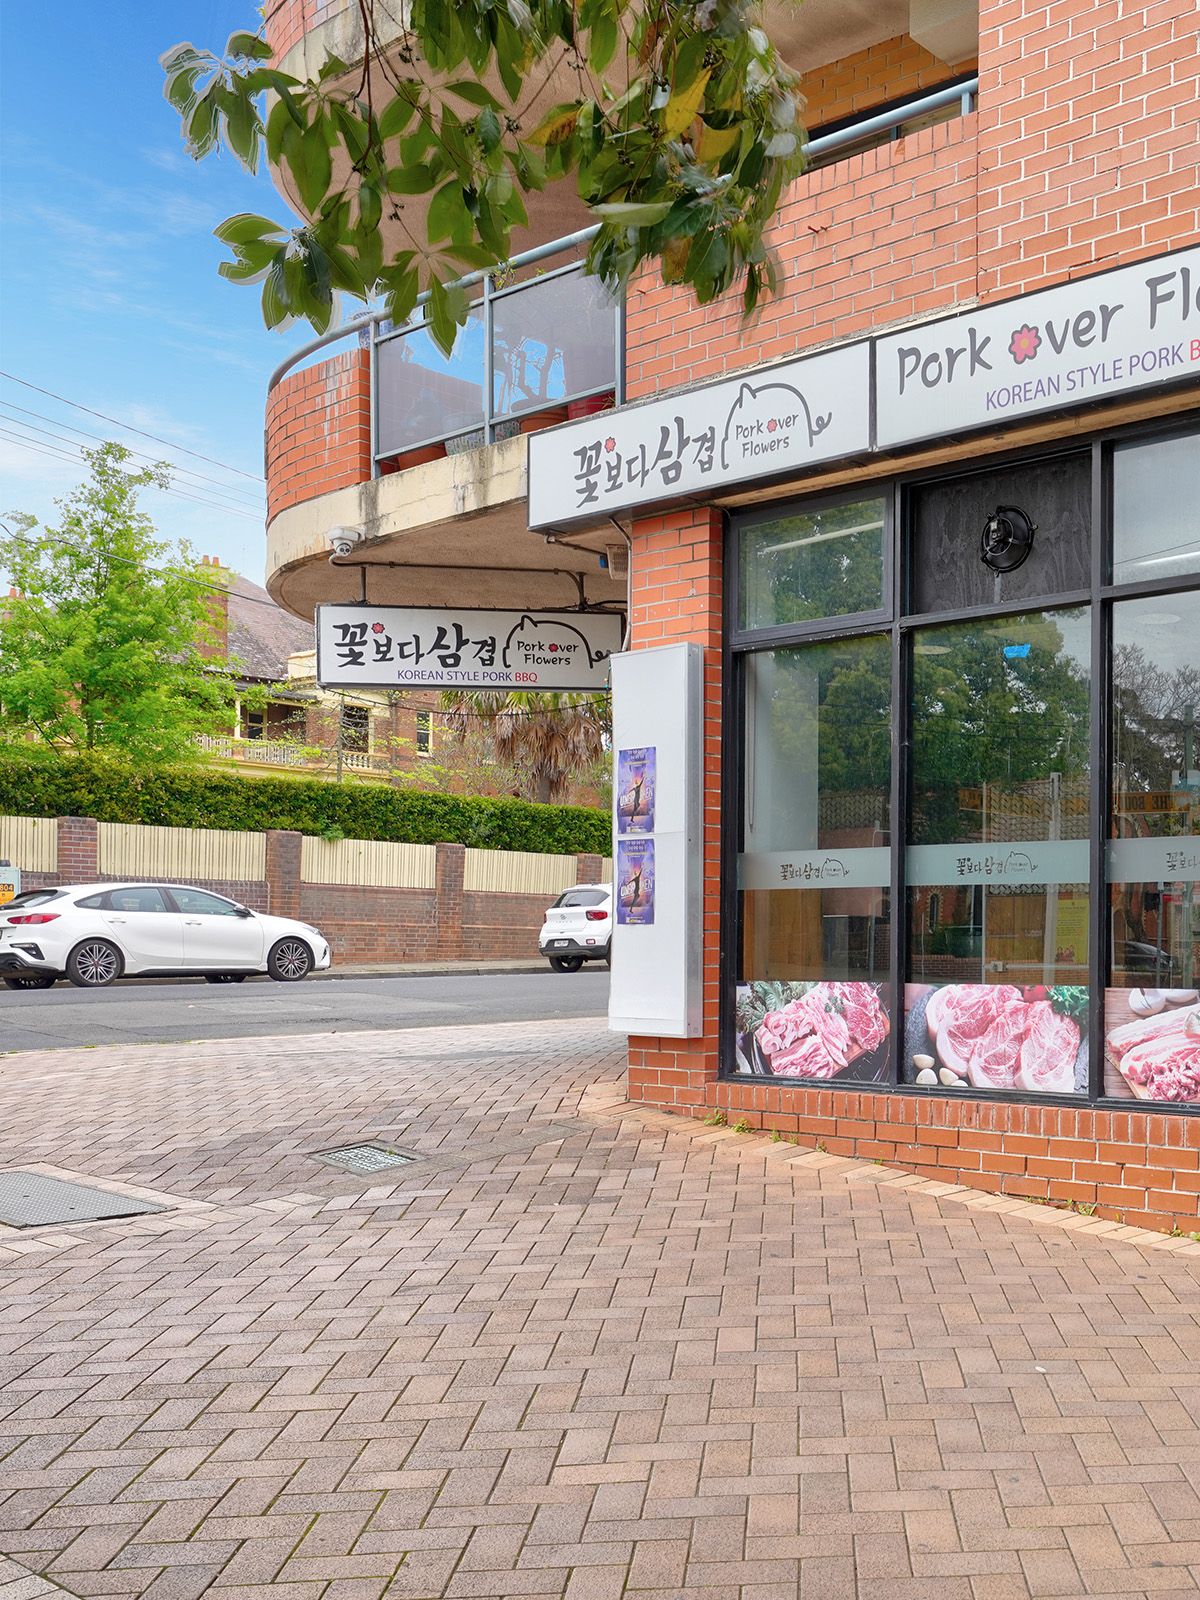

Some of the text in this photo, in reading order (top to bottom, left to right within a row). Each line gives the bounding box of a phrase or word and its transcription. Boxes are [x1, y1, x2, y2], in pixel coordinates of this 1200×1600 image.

[897, 326, 992, 396] Pork
[986, 374, 1060, 411] KOREAN
[1066, 358, 1122, 392] STYLE
[1128, 342, 1184, 376] PORK
[735, 419, 764, 440] Pork
[741, 436, 790, 459] Flowers
[517, 640, 545, 652] Pork
[524, 653, 571, 666] Flowers
[397, 669, 538, 684] KOREAN STYLE PORK BBQ
